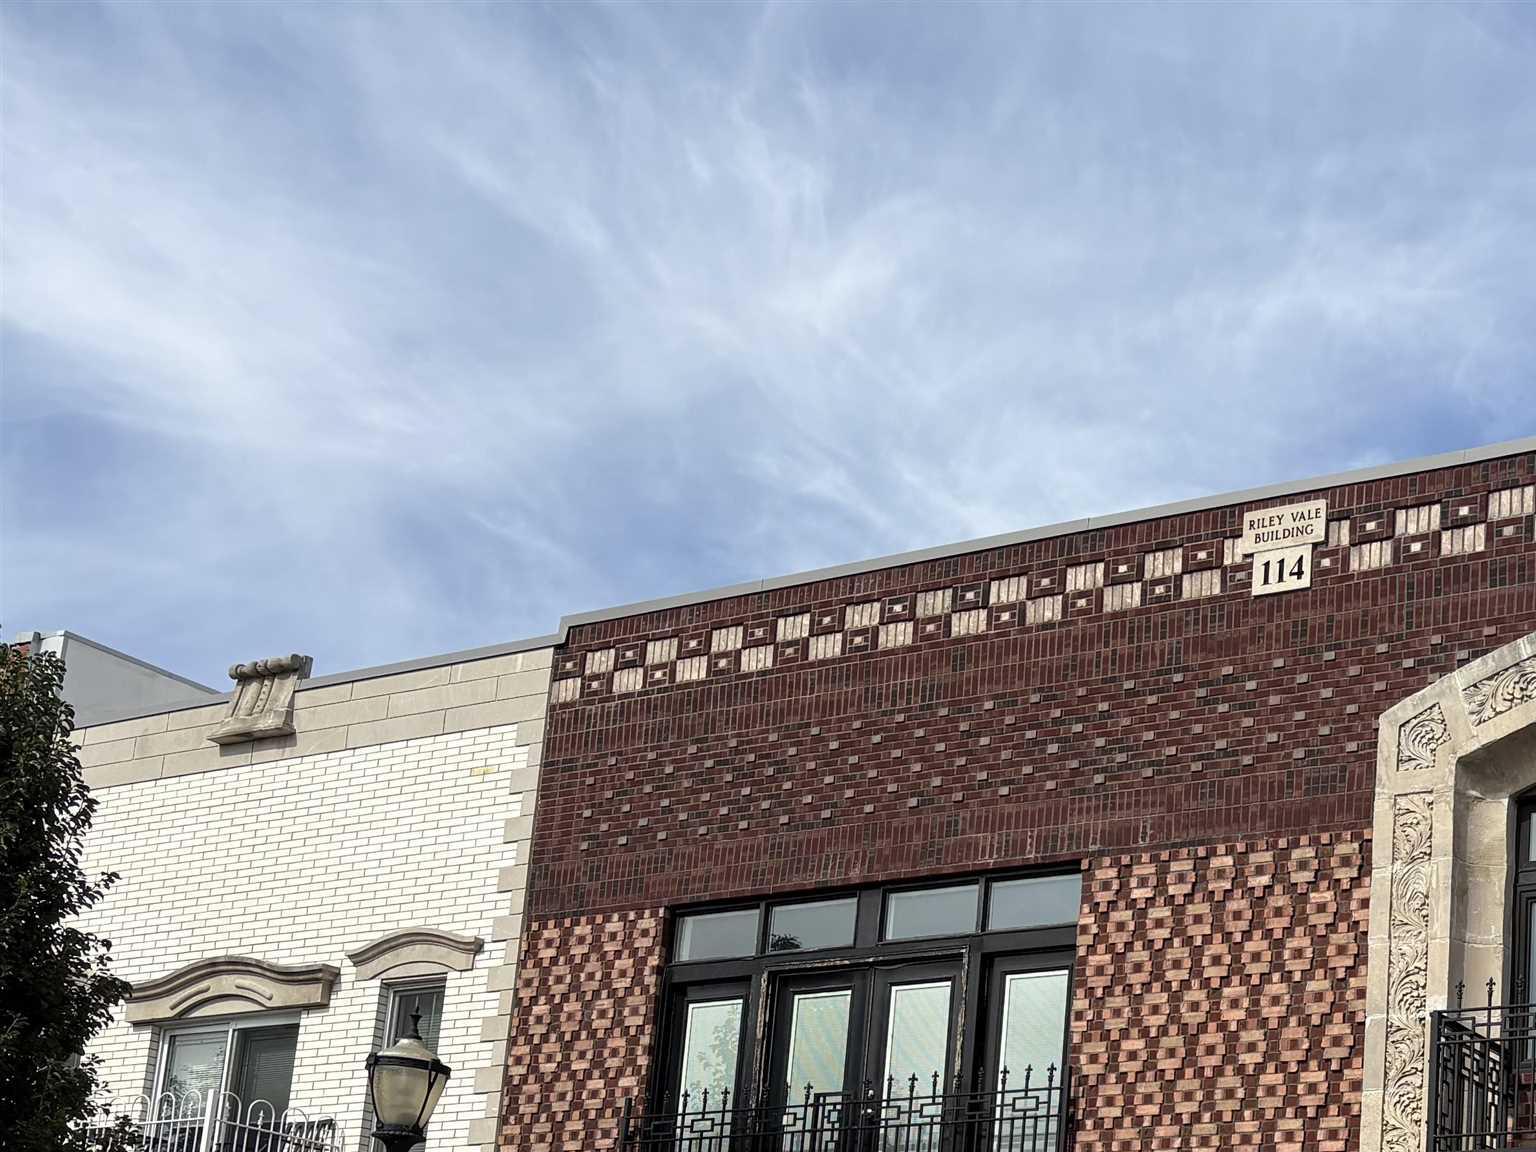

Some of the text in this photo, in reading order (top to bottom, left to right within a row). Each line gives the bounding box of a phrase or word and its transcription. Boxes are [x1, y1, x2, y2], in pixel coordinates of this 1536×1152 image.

[1248, 508, 1322, 530] RILEY VALE
[1254, 524, 1314, 544] BUILDING
[1260, 554, 1305, 586] 114
